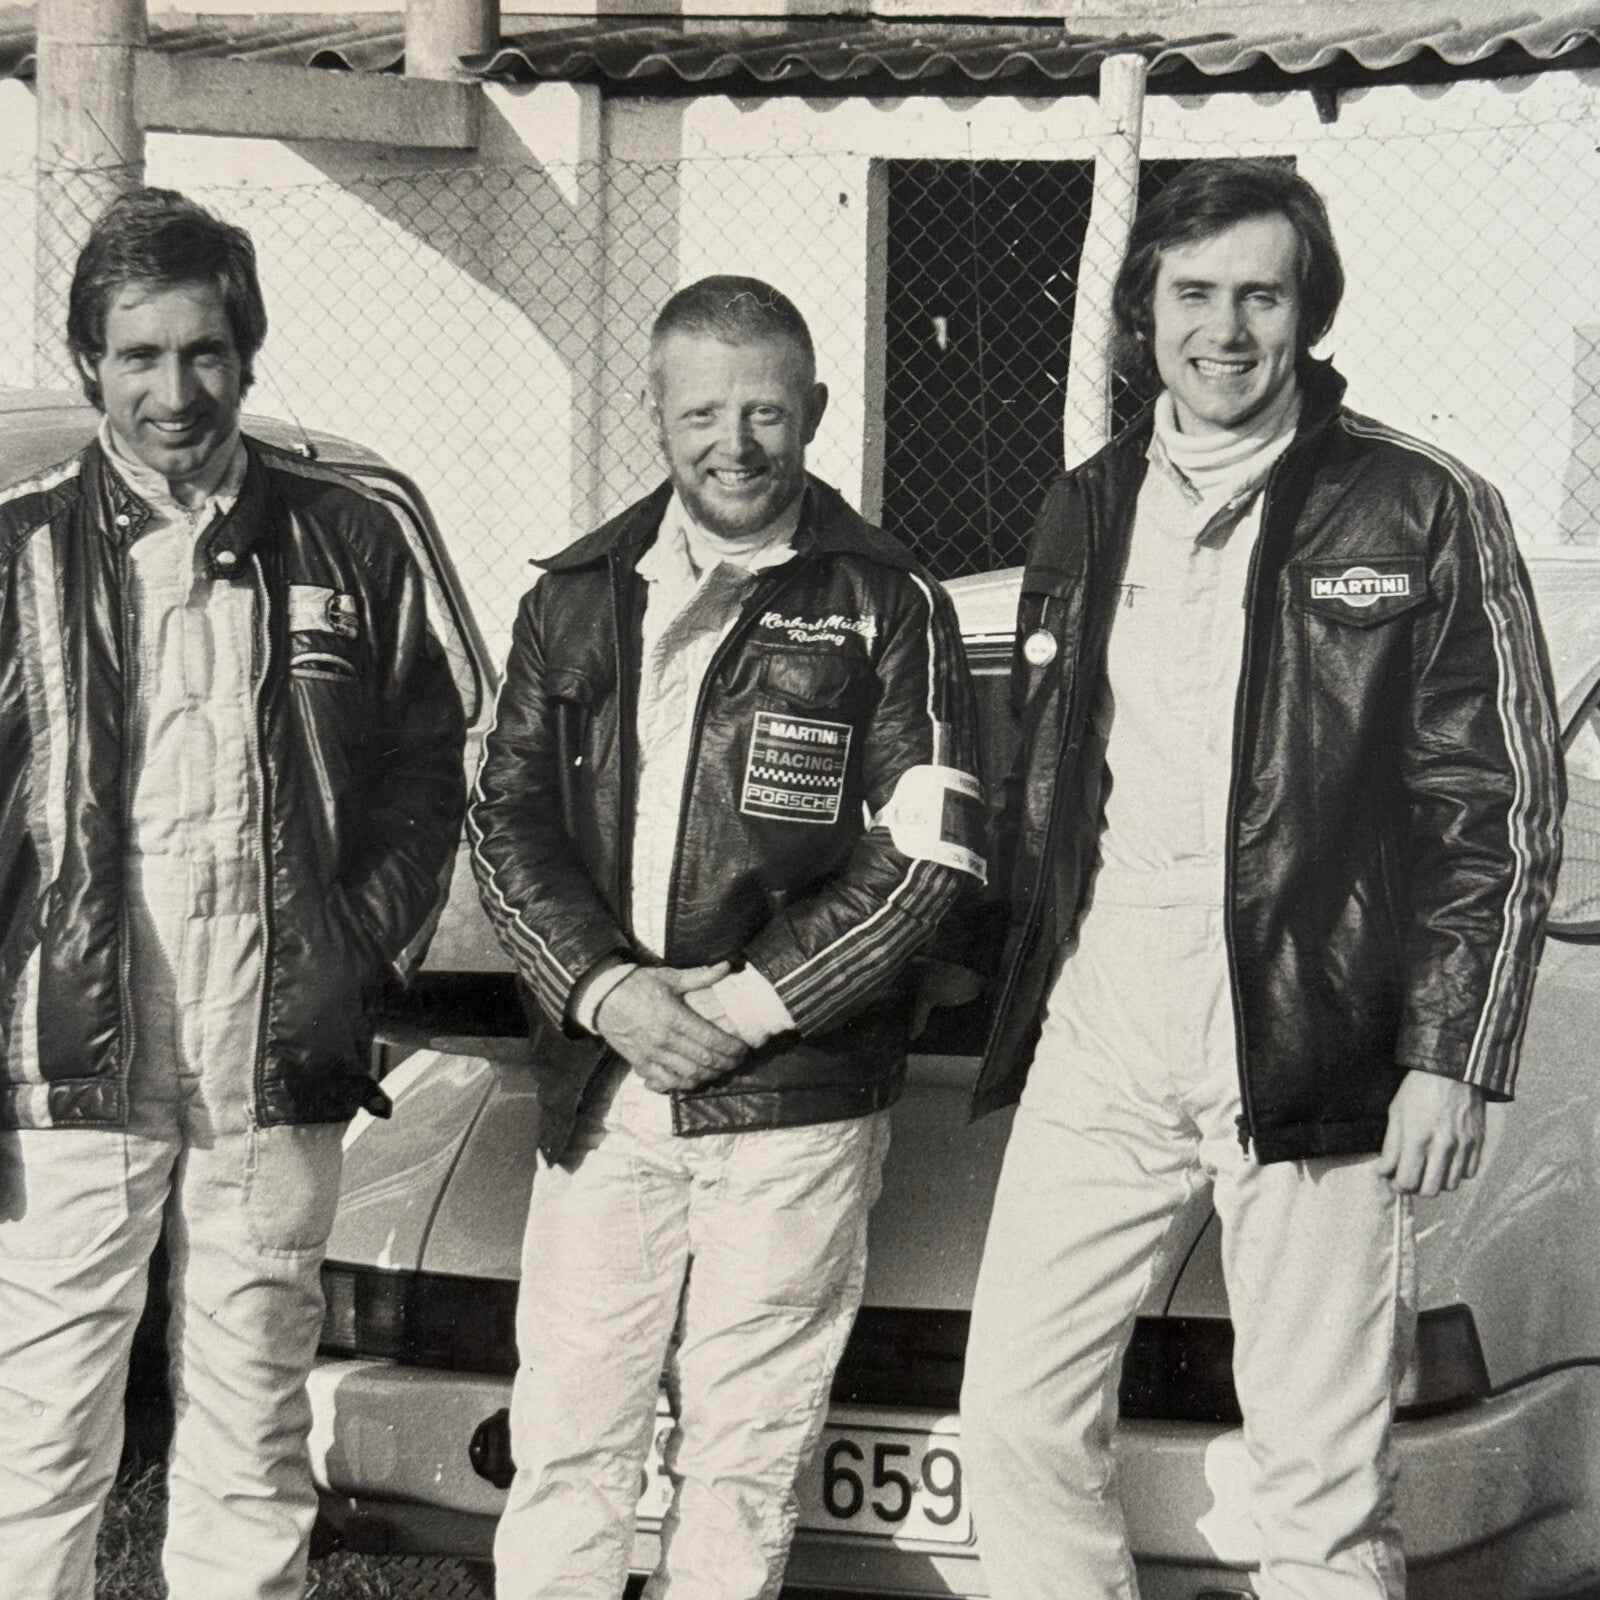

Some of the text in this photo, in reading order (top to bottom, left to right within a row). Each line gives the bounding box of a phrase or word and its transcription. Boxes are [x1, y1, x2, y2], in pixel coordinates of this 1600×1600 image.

[1316, 578, 1404, 595] MARTINI
[787, 629, 846, 647] Racing
[769, 721, 838, 745] MARTINI
[765, 748, 833, 771] RACING
[746, 786, 837, 810] PORSCHE
[823, 1438, 962, 1525] 659
